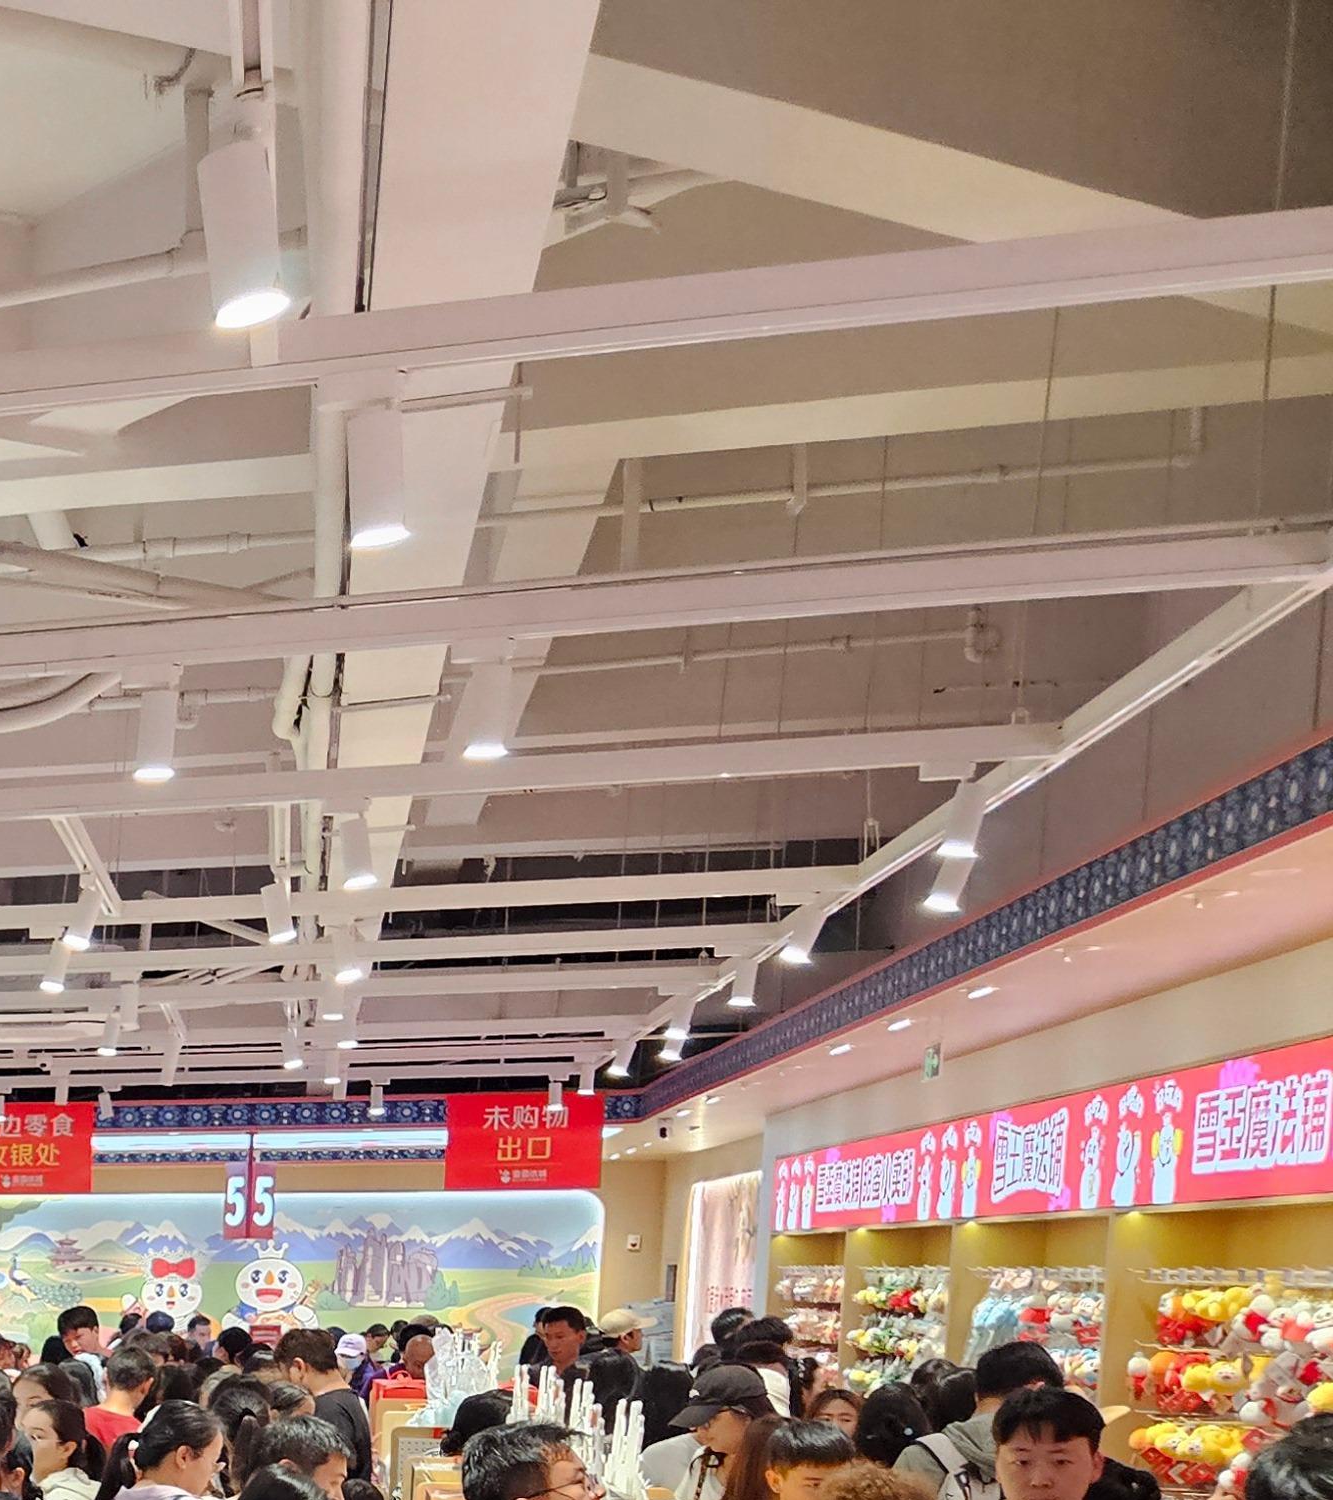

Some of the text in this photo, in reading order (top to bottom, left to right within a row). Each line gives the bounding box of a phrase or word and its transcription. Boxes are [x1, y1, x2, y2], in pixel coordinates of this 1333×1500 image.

[483, 1104, 569, 1130] 未购物
[497, 1136, 553, 1162] 出口
[225, 1176, 246, 1227] 5
[253, 1176, 274, 1227] 5
